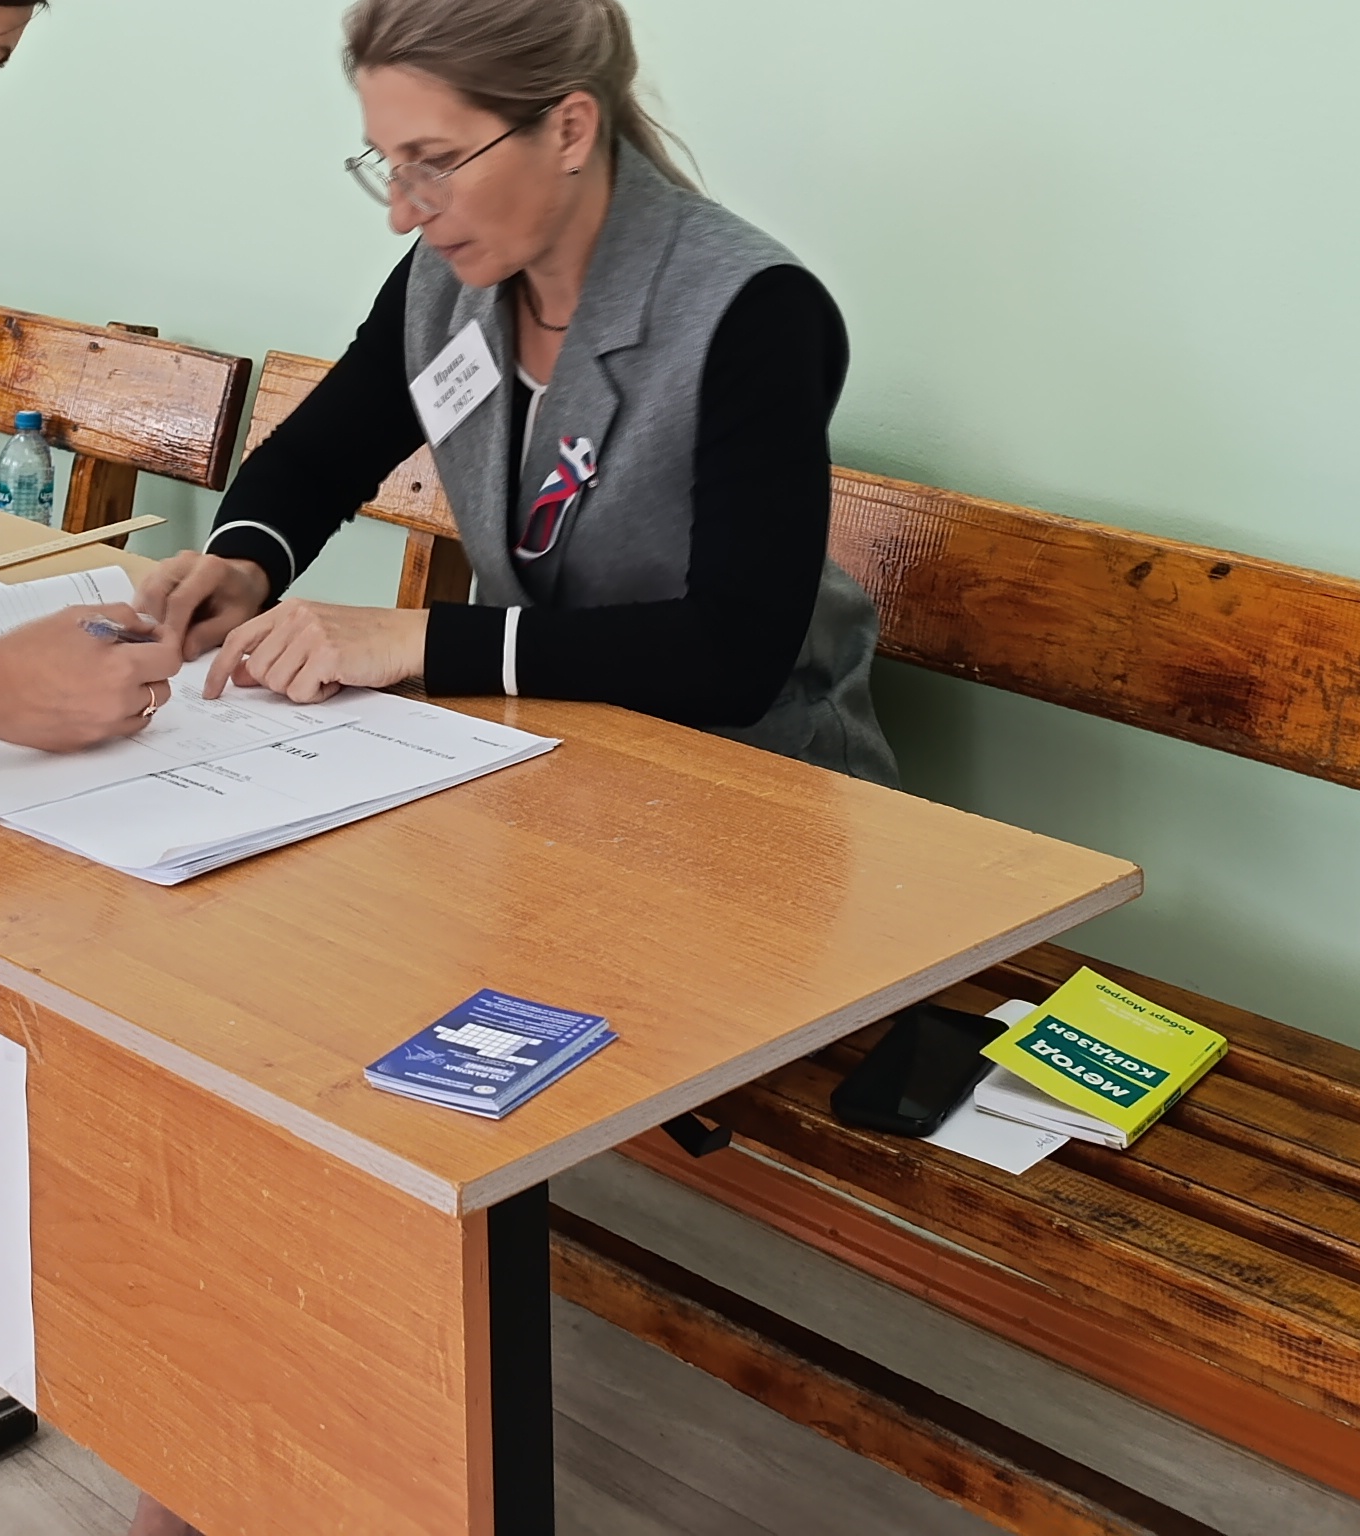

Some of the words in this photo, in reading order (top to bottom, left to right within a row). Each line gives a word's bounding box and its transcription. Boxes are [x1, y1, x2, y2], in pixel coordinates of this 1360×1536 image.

[433, 353, 465, 386] Ирина
[1096, 983, 1146, 1013] Маурер
[1149, 1010, 1194, 1036] Роберт
[1046, 1023, 1156, 1079] кайдзен
[1030, 1039, 1130, 1098] метод
